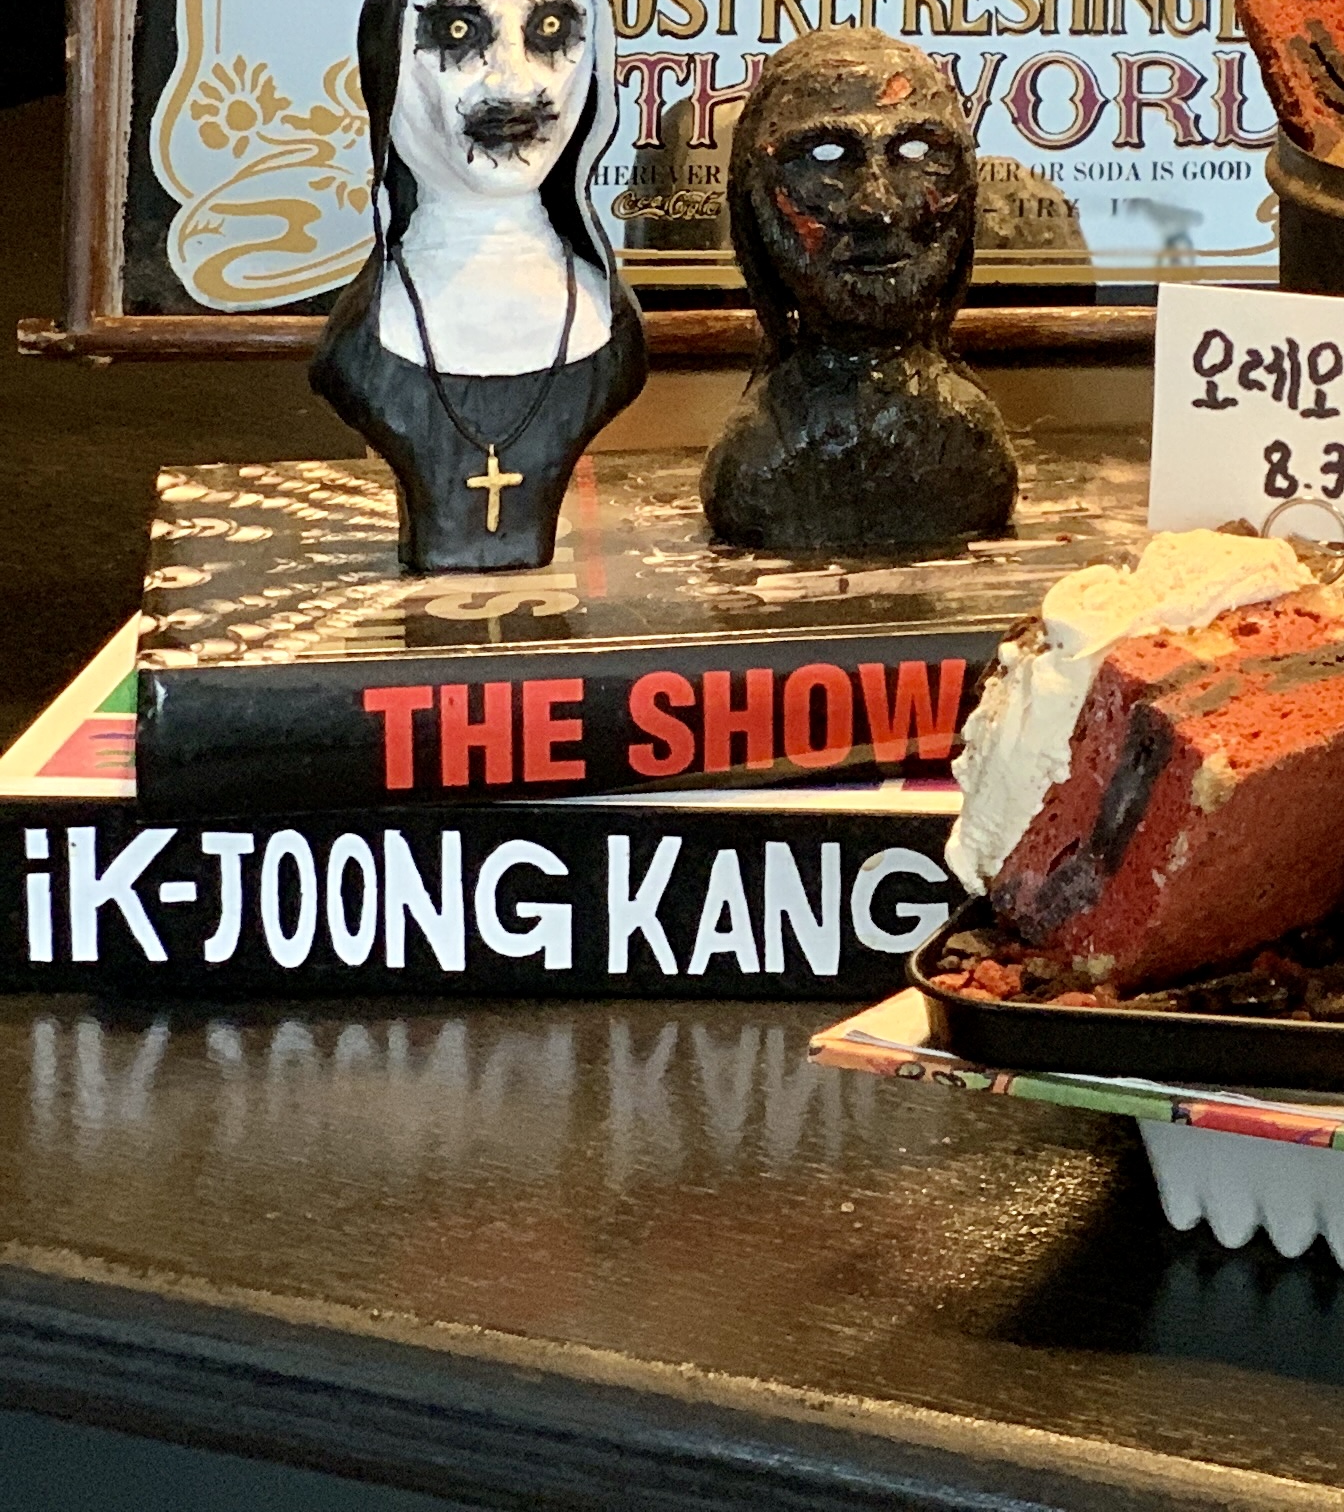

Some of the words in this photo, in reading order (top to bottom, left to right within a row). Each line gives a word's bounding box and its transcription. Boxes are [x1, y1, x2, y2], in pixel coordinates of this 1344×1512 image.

[614, 51, 764, 150] TH
[593, 165, 721, 186] HEREVER
[1030, 162, 1065, 183] OR
[1073, 161, 1142, 183] SODA
[1150, 161, 1174, 182] IS
[1181, 159, 1252, 182] GOOD
[1012, 197, 1081, 219] TRY
[363, 678, 587, 791] THE
[628, 658, 967, 781] SHOW
[607, 834, 950, 977] KANG
